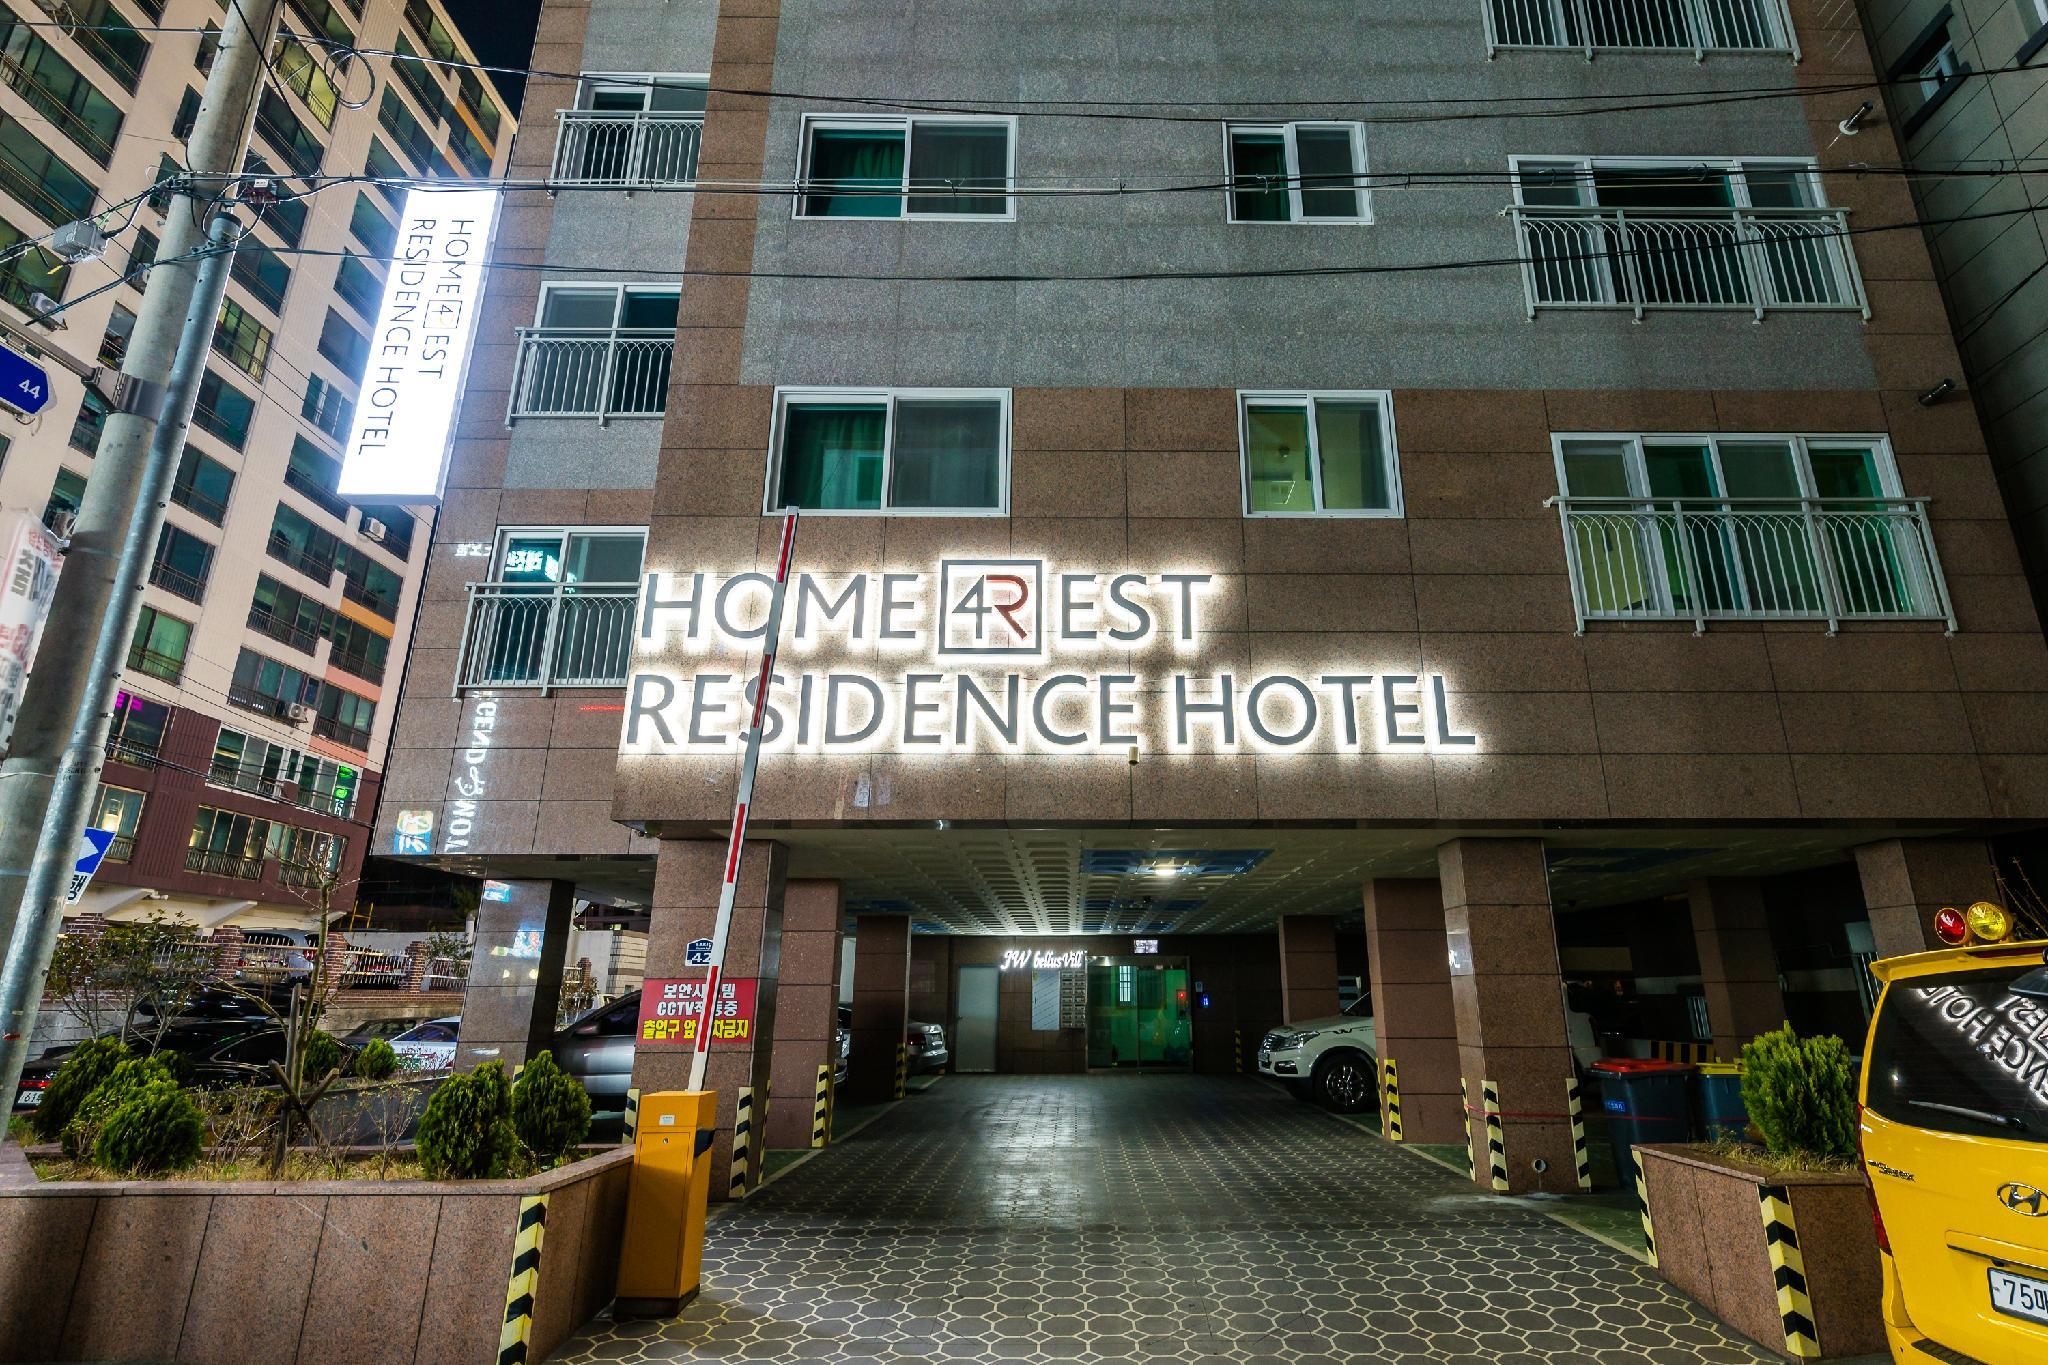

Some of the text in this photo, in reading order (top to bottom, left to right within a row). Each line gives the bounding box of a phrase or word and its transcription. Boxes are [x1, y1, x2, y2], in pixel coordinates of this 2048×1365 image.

[434, 219, 475, 294] HOME
[358, 218, 437, 456] RESIDENCE HOTEL
[417, 334, 450, 379] EST
[18, 379, 41, 400] 44
[641, 571, 920, 640] HOME
[1060, 573, 1213, 641] EST
[626, 673, 1477, 746] RESIDENCE HOTEL
[663, 983, 736, 999] 보안시템
[642, 1019, 749, 1039] 출입구 앞 차금지
